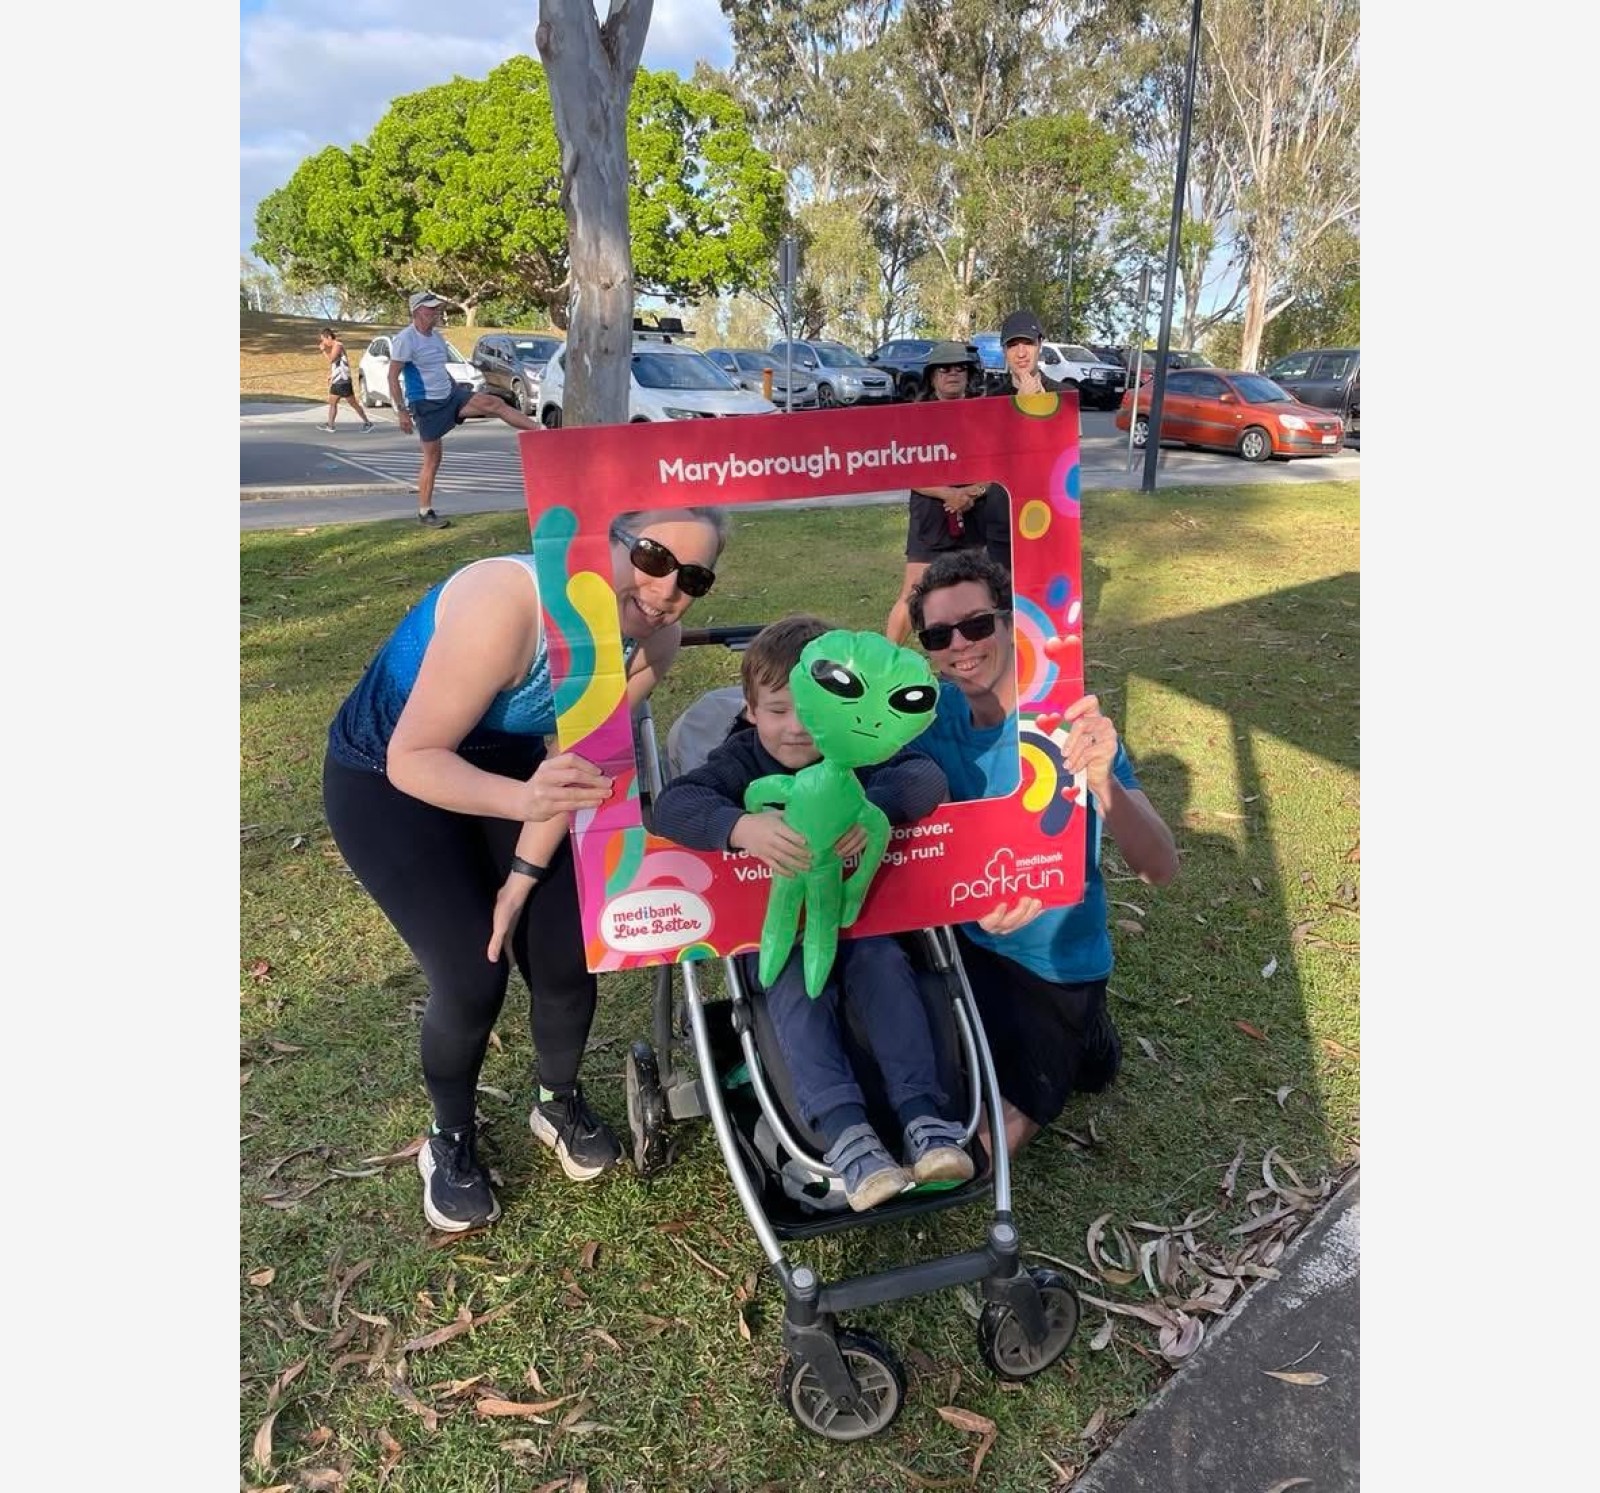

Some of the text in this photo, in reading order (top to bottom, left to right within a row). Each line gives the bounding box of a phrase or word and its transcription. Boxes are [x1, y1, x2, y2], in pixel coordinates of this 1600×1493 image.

[659, 440, 958, 486] Maryborough parkrun.
[722, 821, 954, 861] Fre forever.
[1015, 851, 1063, 868] medibank
[733, 841, 945, 882] Volu al og, run!
[950, 863, 1065, 909] parkrun
[613, 902, 682, 923] medibank
[613, 918, 702, 940] Live Better
